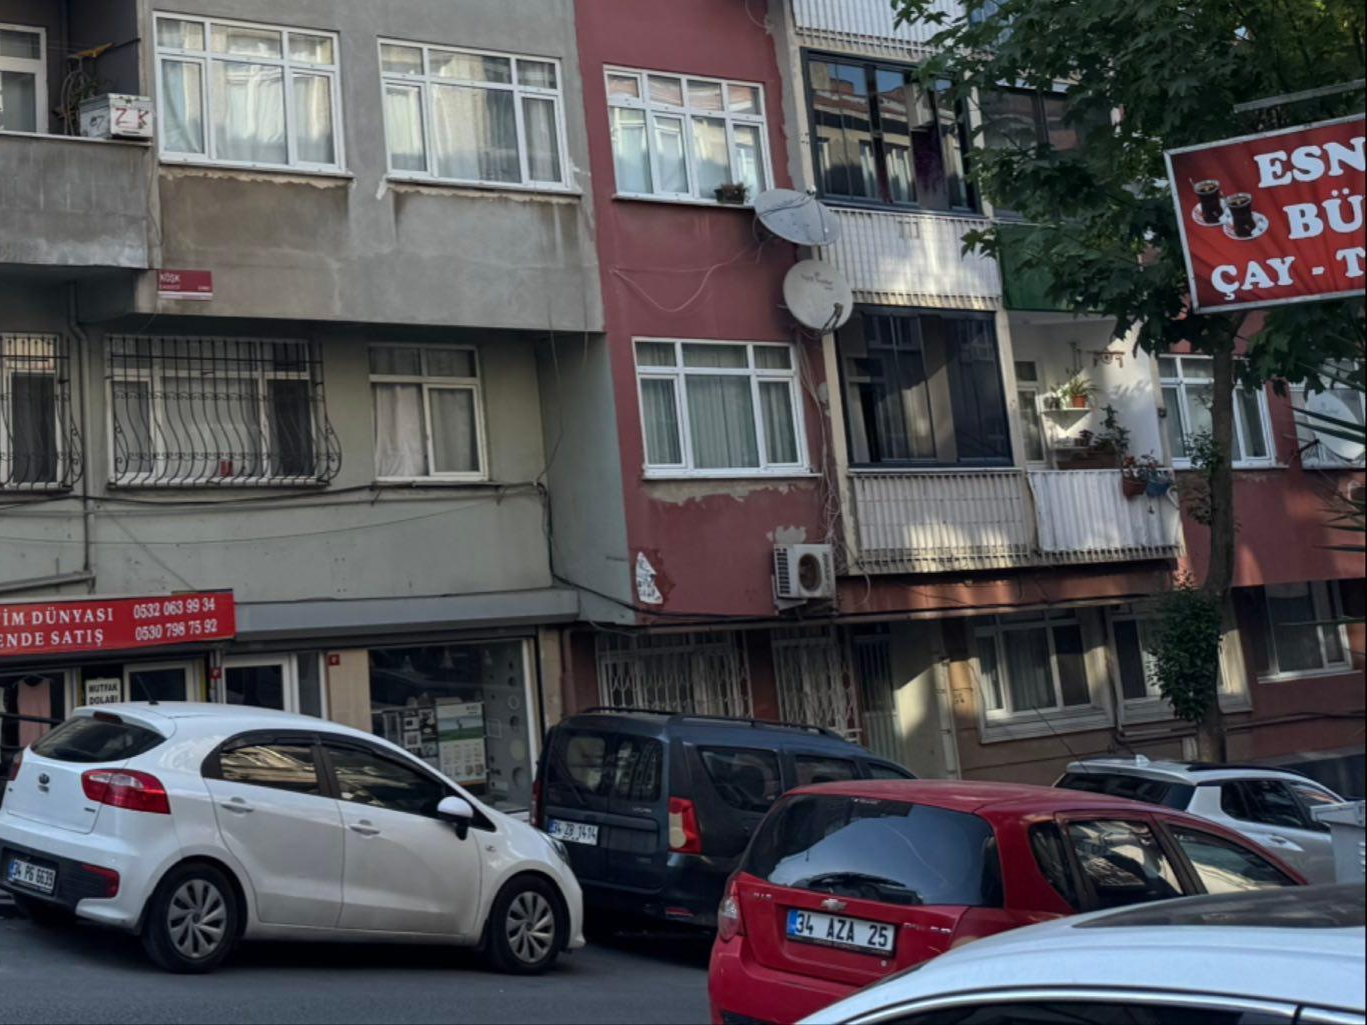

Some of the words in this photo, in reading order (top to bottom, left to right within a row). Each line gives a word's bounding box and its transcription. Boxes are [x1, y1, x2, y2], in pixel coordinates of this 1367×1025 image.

[1253, 137, 1365, 188] ESN
[1211, 256, 1296, 301] ÇAY
[32, 606, 114, 625] DÜNYASI
[133, 602, 160, 619] 0532
[186, 598, 200, 614] 99
[202, 597, 216, 612] 34
[50, 628, 104, 647] SATIŞ
[135, 624, 163, 641] 0530
[188, 620, 202, 635] 75
[204, 618, 218, 633] 92
[796, 913, 814, 935] 34
[826, 917, 855, 943] AZA
[867, 924, 888, 948] 25
